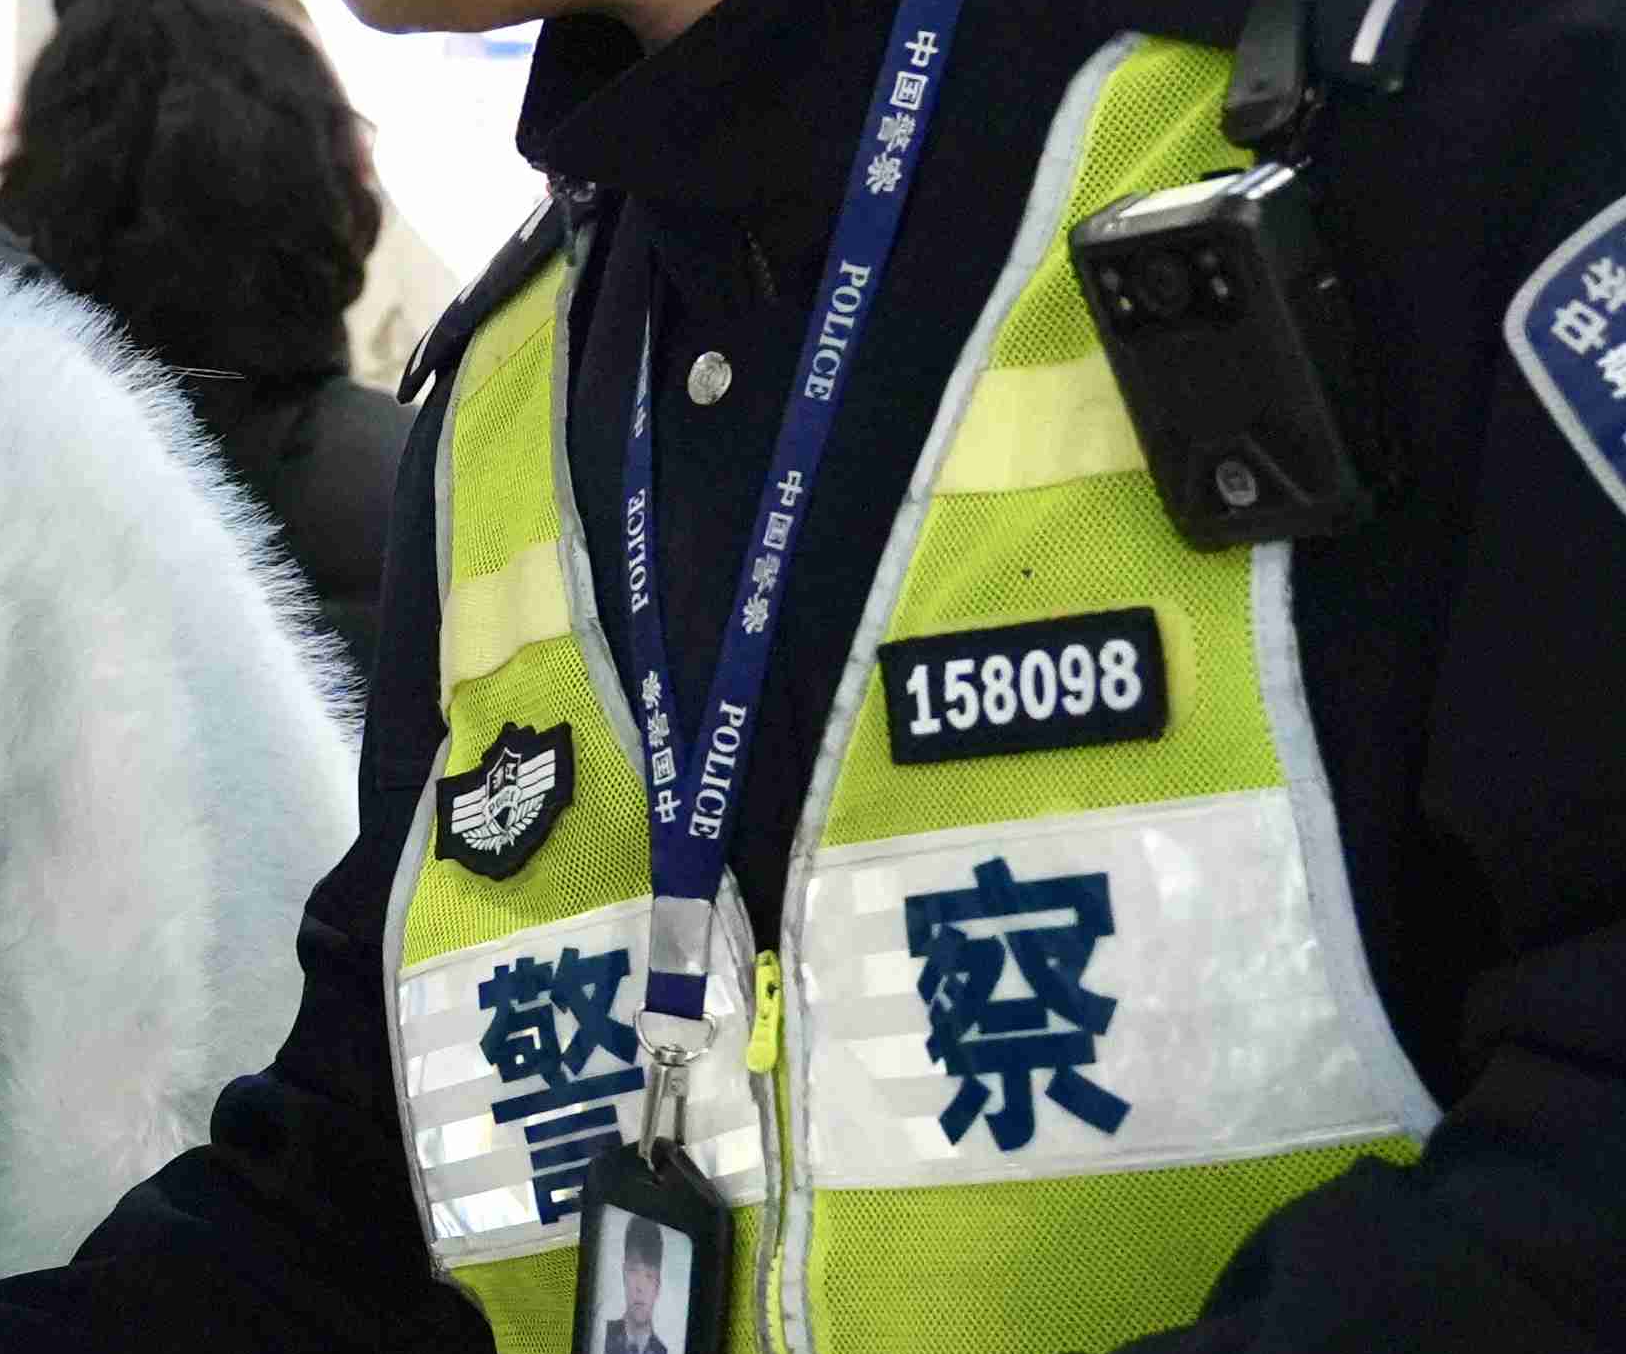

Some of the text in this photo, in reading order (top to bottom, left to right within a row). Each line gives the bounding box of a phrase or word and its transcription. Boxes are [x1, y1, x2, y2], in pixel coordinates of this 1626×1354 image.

[867, 30, 939, 194] 中国警察
[803, 259, 871, 401] POLICE
[628, 488, 647, 614] POLICE
[742, 470, 804, 635] 中国警察
[642, 670, 681, 824] 中国警察
[907, 639, 1142, 736] 158098
[689, 700, 747, 841] POLICE
